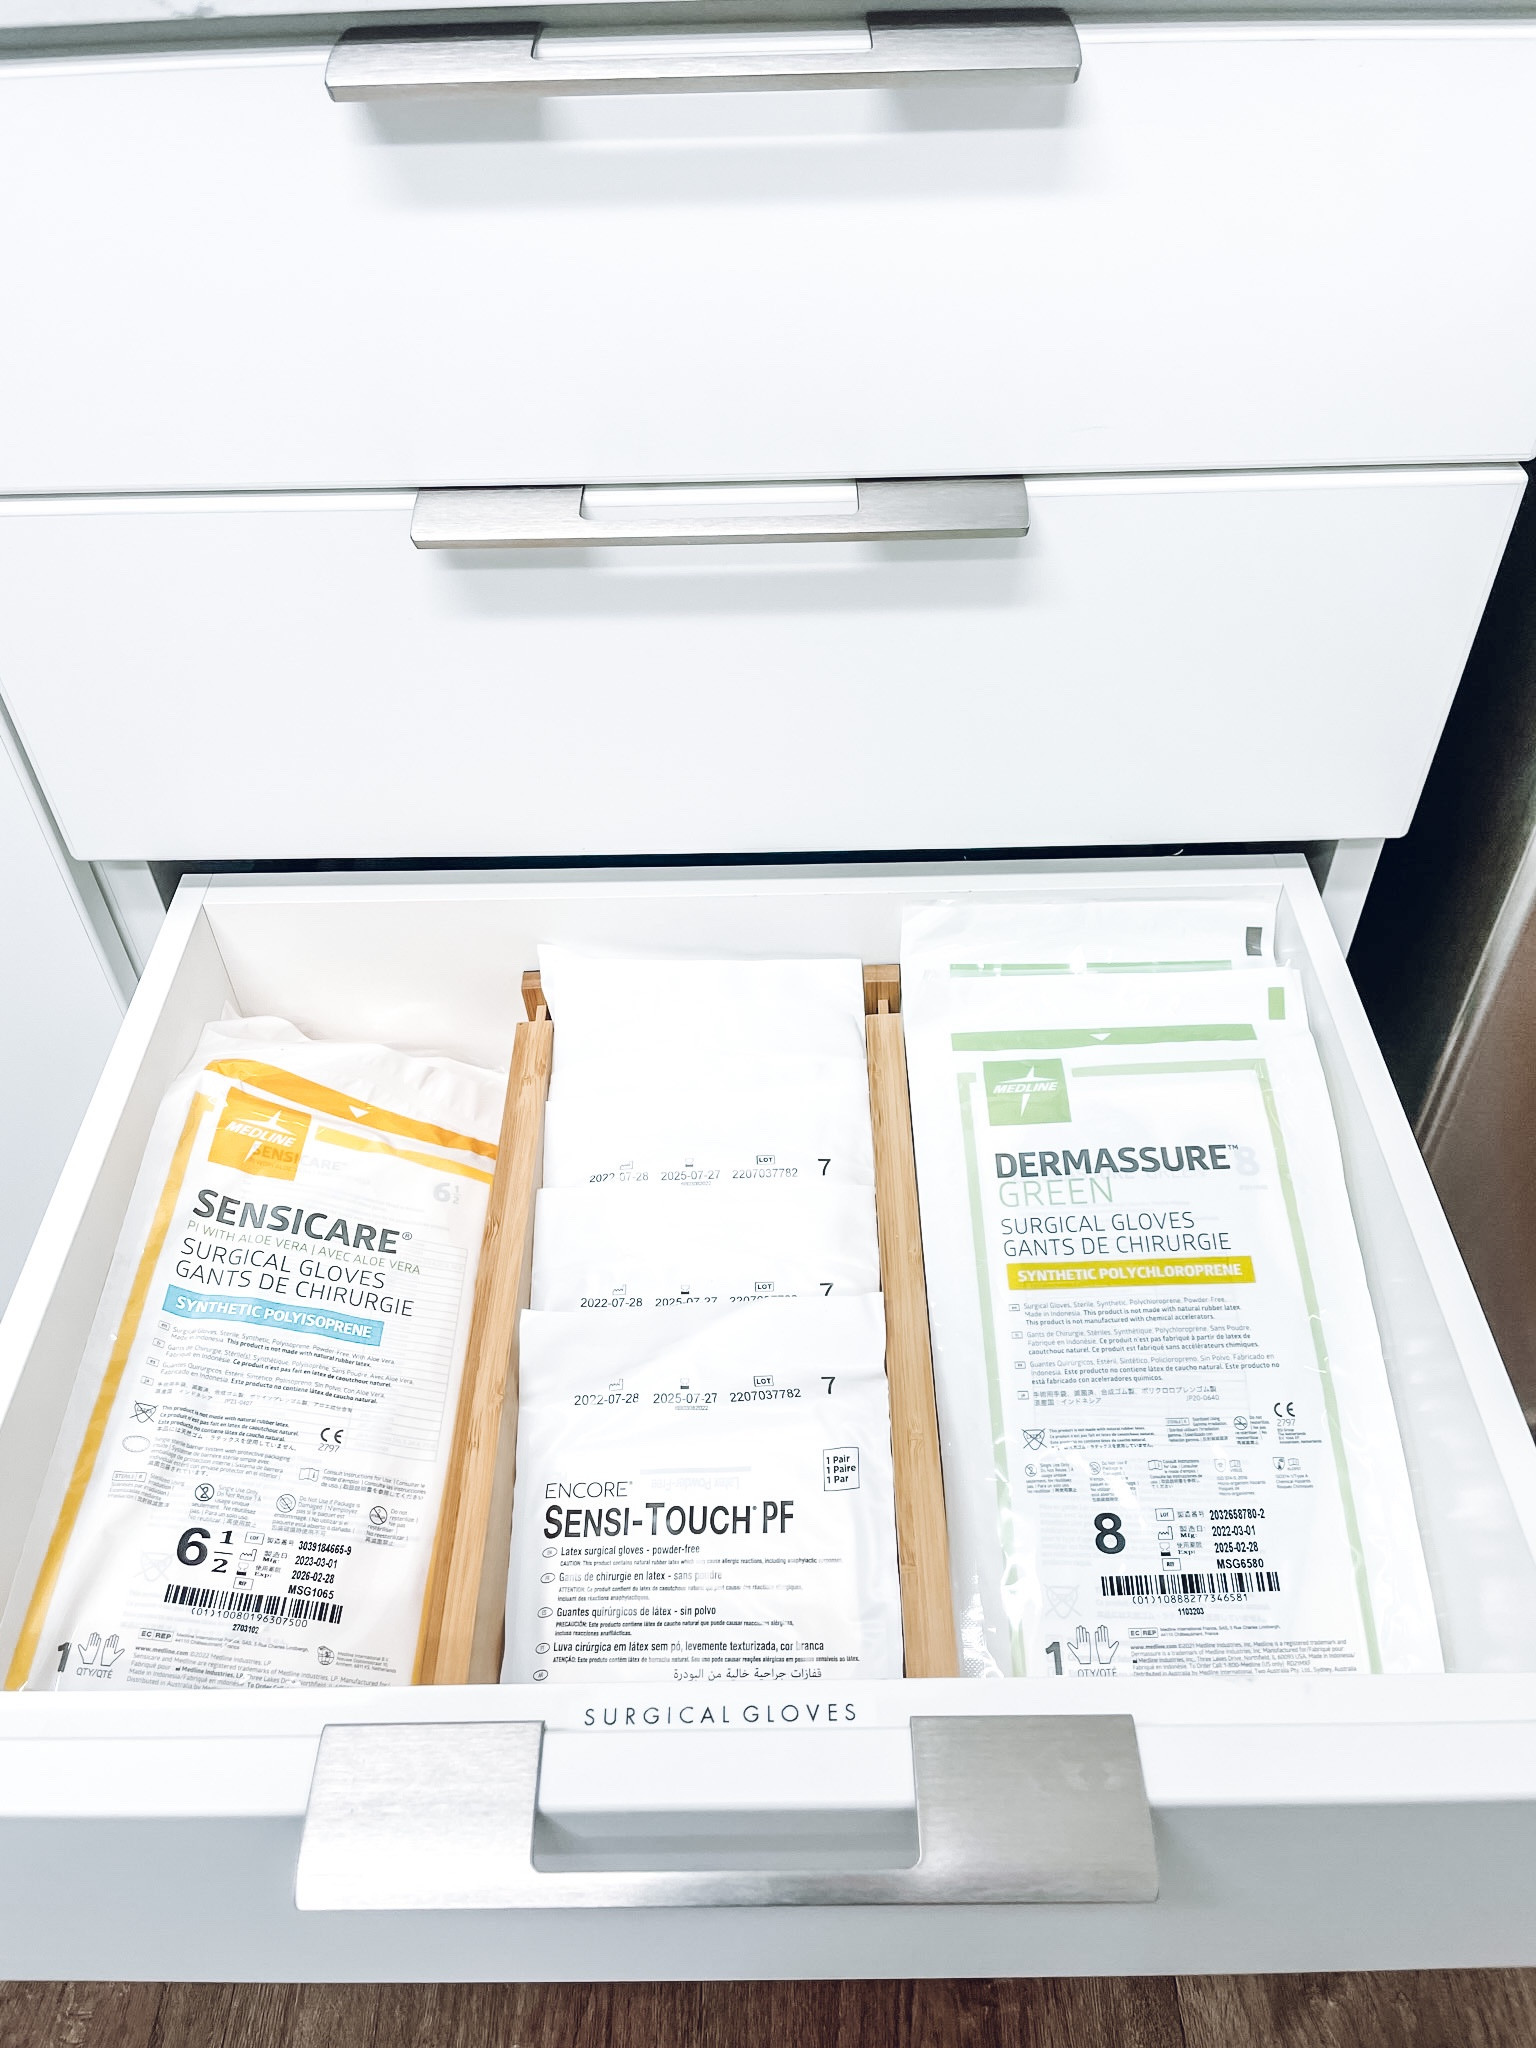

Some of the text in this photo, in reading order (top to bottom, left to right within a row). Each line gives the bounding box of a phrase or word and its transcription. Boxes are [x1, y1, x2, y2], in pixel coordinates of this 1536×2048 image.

[992, 1081, 1059, 1094] MEDLINE
[224, 1120, 298, 1148] MEDLINE
[660, 1170, 720, 1181] 2025-07-27
[732, 1167, 798, 1179] 2207037782
[817, 1158, 832, 1176] 7
[999, 1176, 1113, 1207] GREEN
[1001, 1211, 1195, 1235] SURGICAL GLOVES
[187, 1220, 200, 1232] PI
[203, 1224, 236, 1241] WITH
[238, 1234, 272, 1246] ALOE
[276, 1237, 308, 1253] VERA
[318, 1246, 351, 1262] AVEC
[353, 1254, 385, 1268] ALOE
[389, 1258, 421, 1275] VERA
[1003, 1232, 1232, 1257] GANTS DE CHIRURGIE
[180, 1237, 386, 1289] SURGICAL GLOVES
[1017, 1263, 1244, 1283] SYNTHETIC POLYCHLOROPRENE
[176, 1259, 415, 1317] GANTS DE CHIRURGIE
[819, 1282, 834, 1297] 7
[580, 1297, 643, 1308] 2022-07-28
[175, 1295, 373, 1339] SYNTHETIC POLYISOPRENE
[1097, 1309, 1123, 1317] product
[1040, 1319, 1065, 1327] product
[227, 1337, 240, 1347] This
[240, 1341, 264, 1352] product
[281, 1346, 298, 1355] made
[299, 1349, 313, 1357] with
[313, 1351, 335, 1361] natural
[335, 1355, 358, 1366] rubber
[820, 1376, 836, 1395] 7
[574, 1388, 802, 1406] 2022-07-28 2025-07-27 2207037782
[1276, 1418, 1296, 1427] 2797
[317, 1442, 340, 1453] 2797
[833, 1455, 851, 1464] Pair
[833, 1464, 857, 1474] Paire
[834, 1475, 849, 1484] Par
[762, 1500, 794, 1534] PF
[1209, 1508, 1266, 1521] 2032658780-2
[1094, 1512, 1126, 1554] 8
[1211, 1525, 1256, 1537] 2022-03-01
[176, 1527, 234, 1574] 6 1 2
[298, 1540, 352, 1556] 3039184665-9
[560, 1546, 582, 1556] Latex
[584, 1546, 616, 1557] surgical
[618, 1545, 644, 1557] gloves
[652, 1544, 700, 1556] powder-free
[1214, 1541, 1259, 1554] 2025-02-28
[294, 1555, 338, 1569] 2023-03-01
[1216, 1558, 1264, 1570] MSG6580
[291, 1570, 335, 1584] 2026-02-28
[584, 1572, 594, 1581] de
[596, 1572, 632, 1583] chirurgie
[633, 1573, 644, 1581] en
[646, 1571, 666, 1581] latex
[673, 1572, 693, 1581] sans
[287, 1584, 335, 1600] MSG1065
[1132, 1592, 1249, 1604] (01)10888277346581
[557, 1607, 590, 1617] Guantes
[591, 1606, 638, 1618] quirúrgicos
[640, 1607, 650, 1616] de
[652, 1605, 672, 1616] látex
[680, 1605, 692, 1616] sin
[694, 1605, 717, 1617] polvo
[1177, 1607, 1205, 1616] 1103203
[141, 1630, 172, 1640] EC REP
[232, 1623, 260, 1635] 2703102
[553, 1642, 573, 1652] Luva
[575, 1641, 612, 1653] cirúrgica
[614, 1643, 627, 1651] em
[629, 1641, 649, 1651] látex
[651, 1643, 668, 1651] sem
[685, 1641, 728, 1651] levemente
[730, 1641, 779, 1652] texturizada,
[780, 1643, 793, 1651] cor
[57, 1641, 73, 1673] 1
[1045, 1641, 1063, 1676] 1
[76, 1666, 114, 1680] QTY/QTÉ
[708, 1669, 722, 1681] من
[726, 1667, 750, 1680] خالية
[754, 1667, 787, 1680] جراحية
[790, 1668, 822, 1679] قفازات
[584, 1703, 856, 1726] SURGICAL GLOVES
